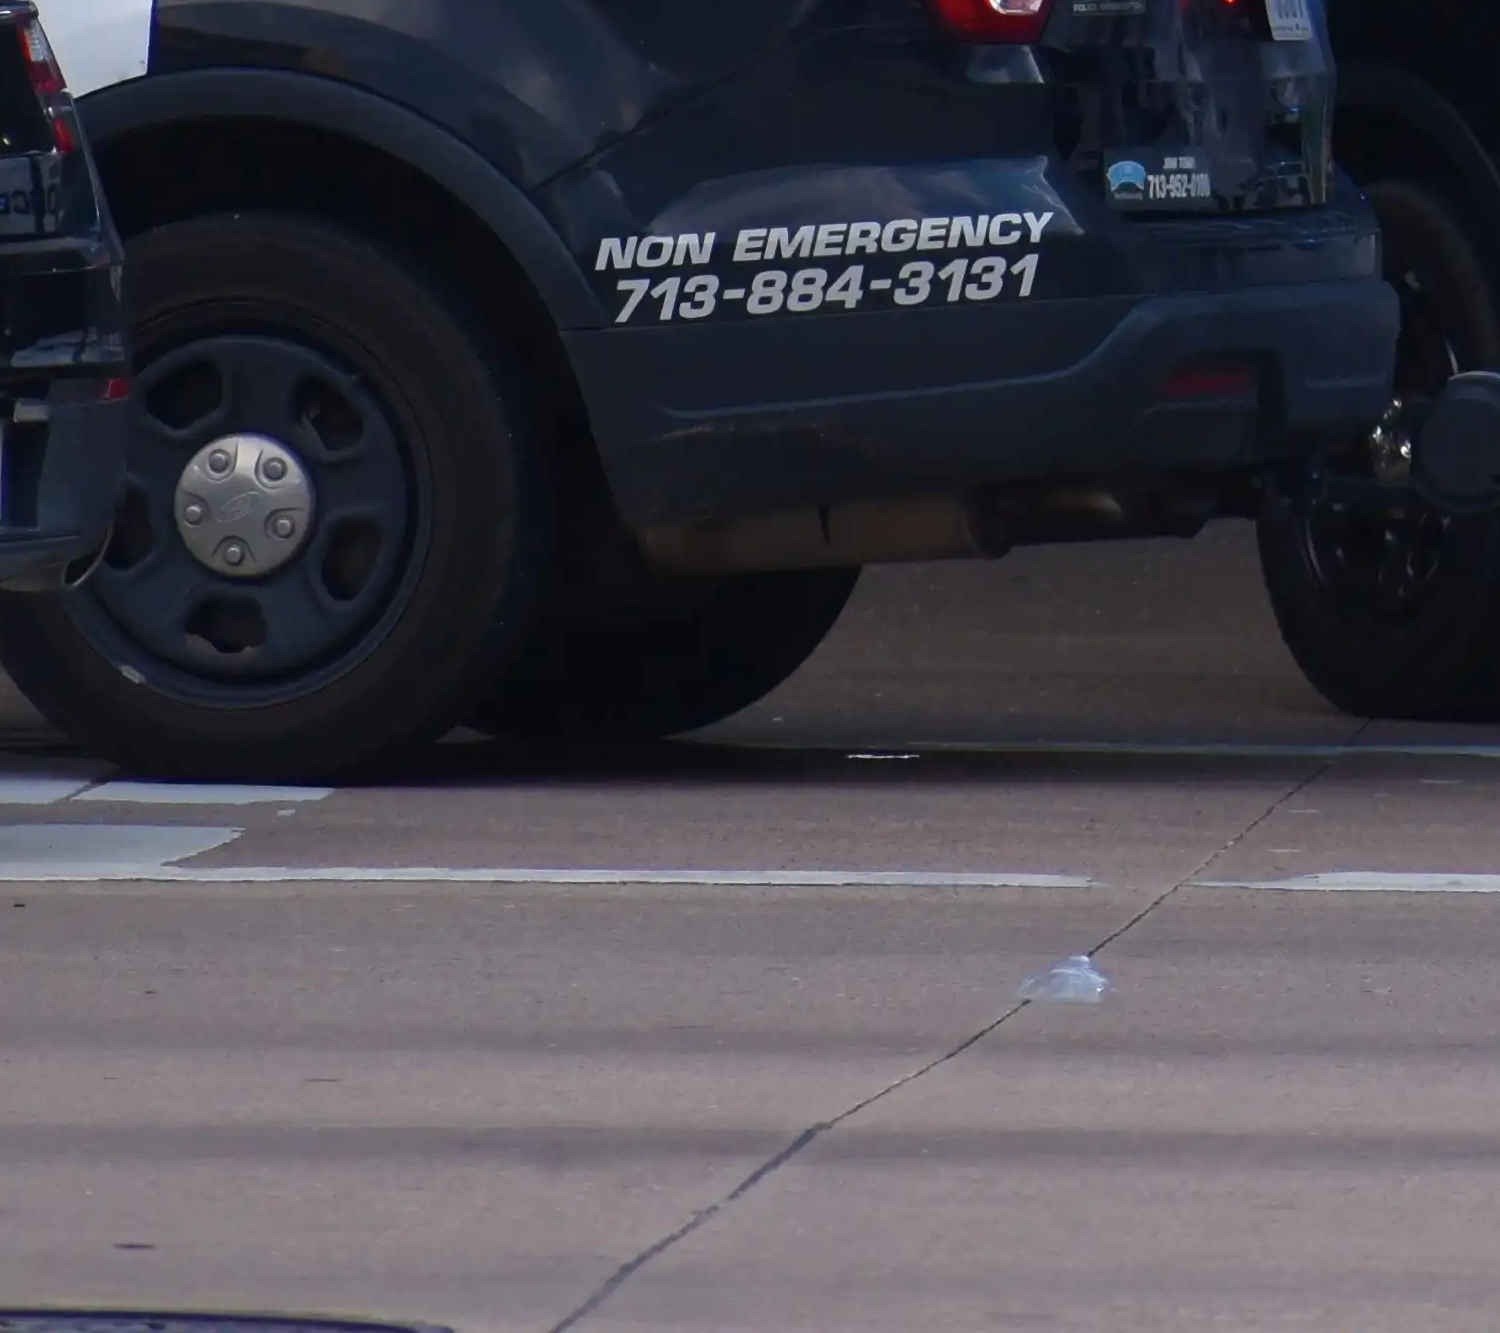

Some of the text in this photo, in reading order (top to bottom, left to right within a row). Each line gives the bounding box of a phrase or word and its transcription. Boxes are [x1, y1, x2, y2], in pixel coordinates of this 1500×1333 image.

[595, 211, 1055, 271] NON EMERGENCY
[615, 253, 1040, 323] 713-884-3131
